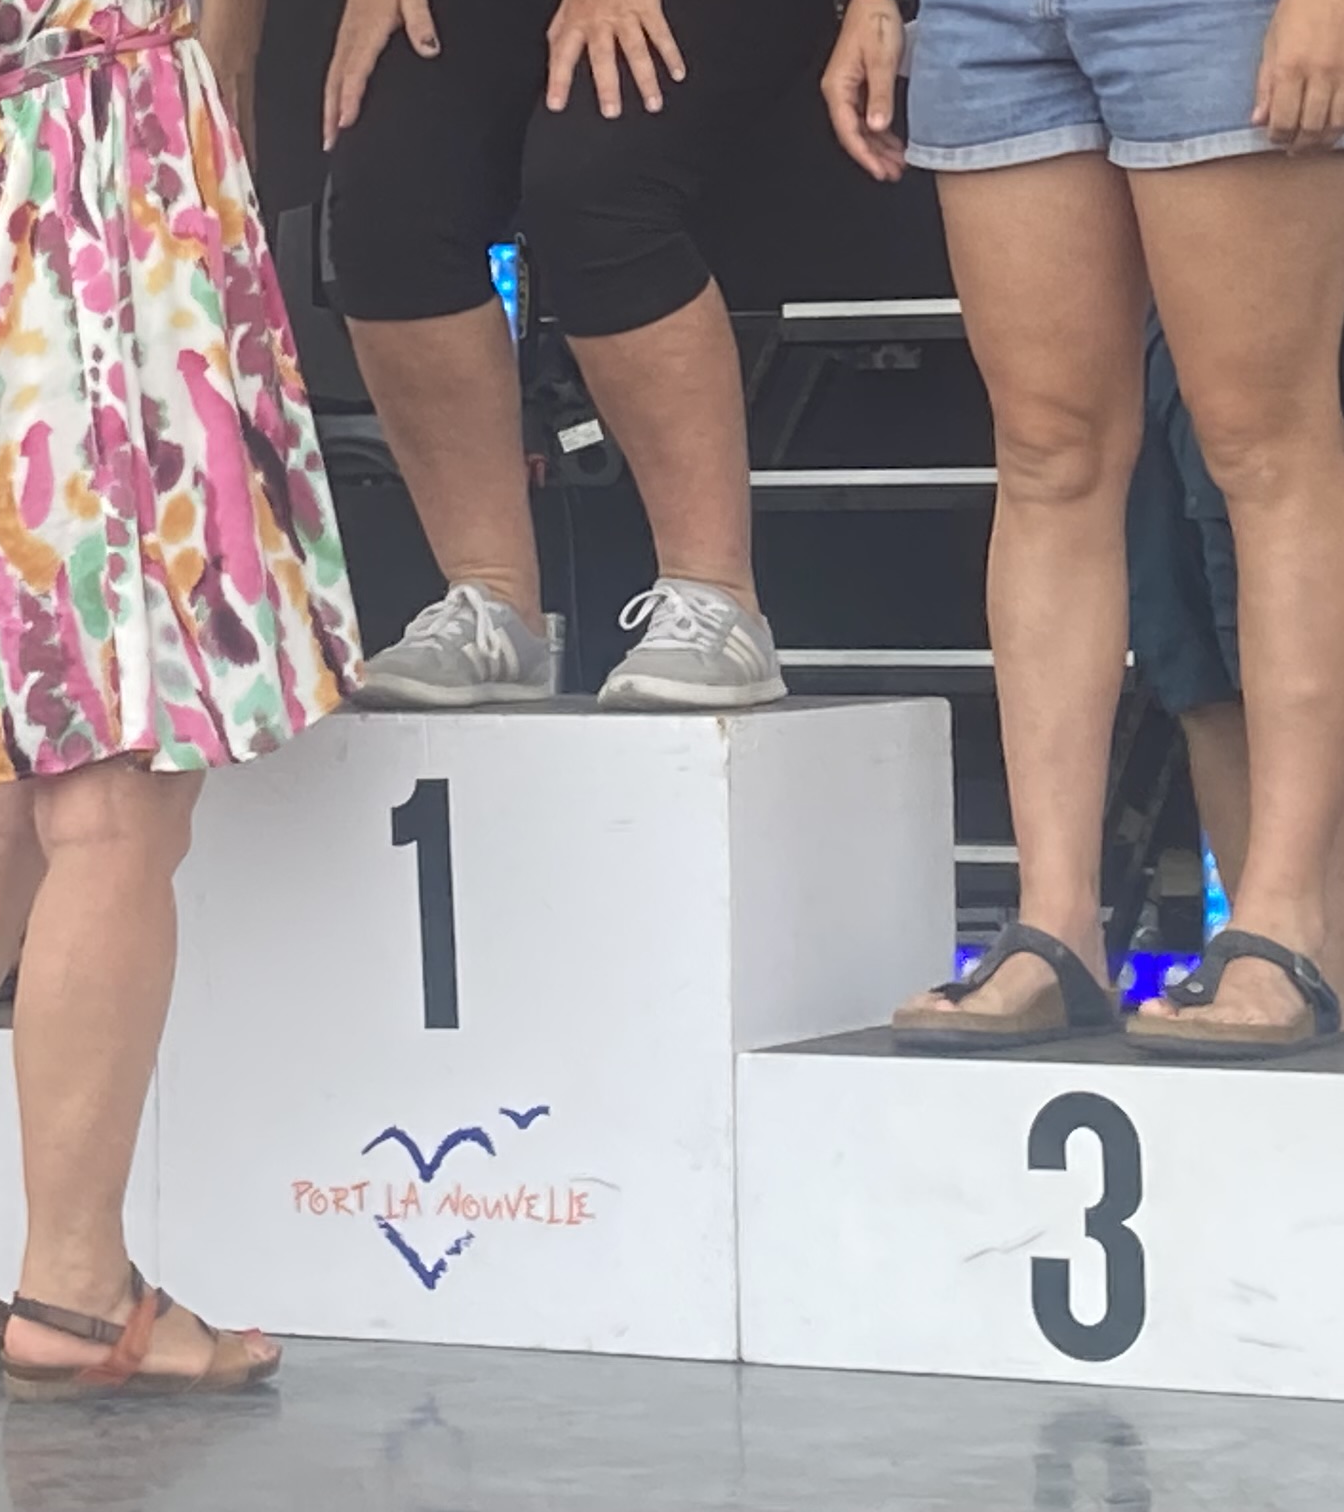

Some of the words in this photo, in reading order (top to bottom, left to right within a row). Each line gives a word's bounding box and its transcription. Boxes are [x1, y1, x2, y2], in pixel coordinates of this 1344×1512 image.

[391, 777, 460, 1029] 1
[291, 1180, 370, 1216] PORT
[385, 1181, 423, 1220] LA
[436, 1183, 596, 1225] NOUVELLE
[1027, 1090, 1147, 1363] 3
